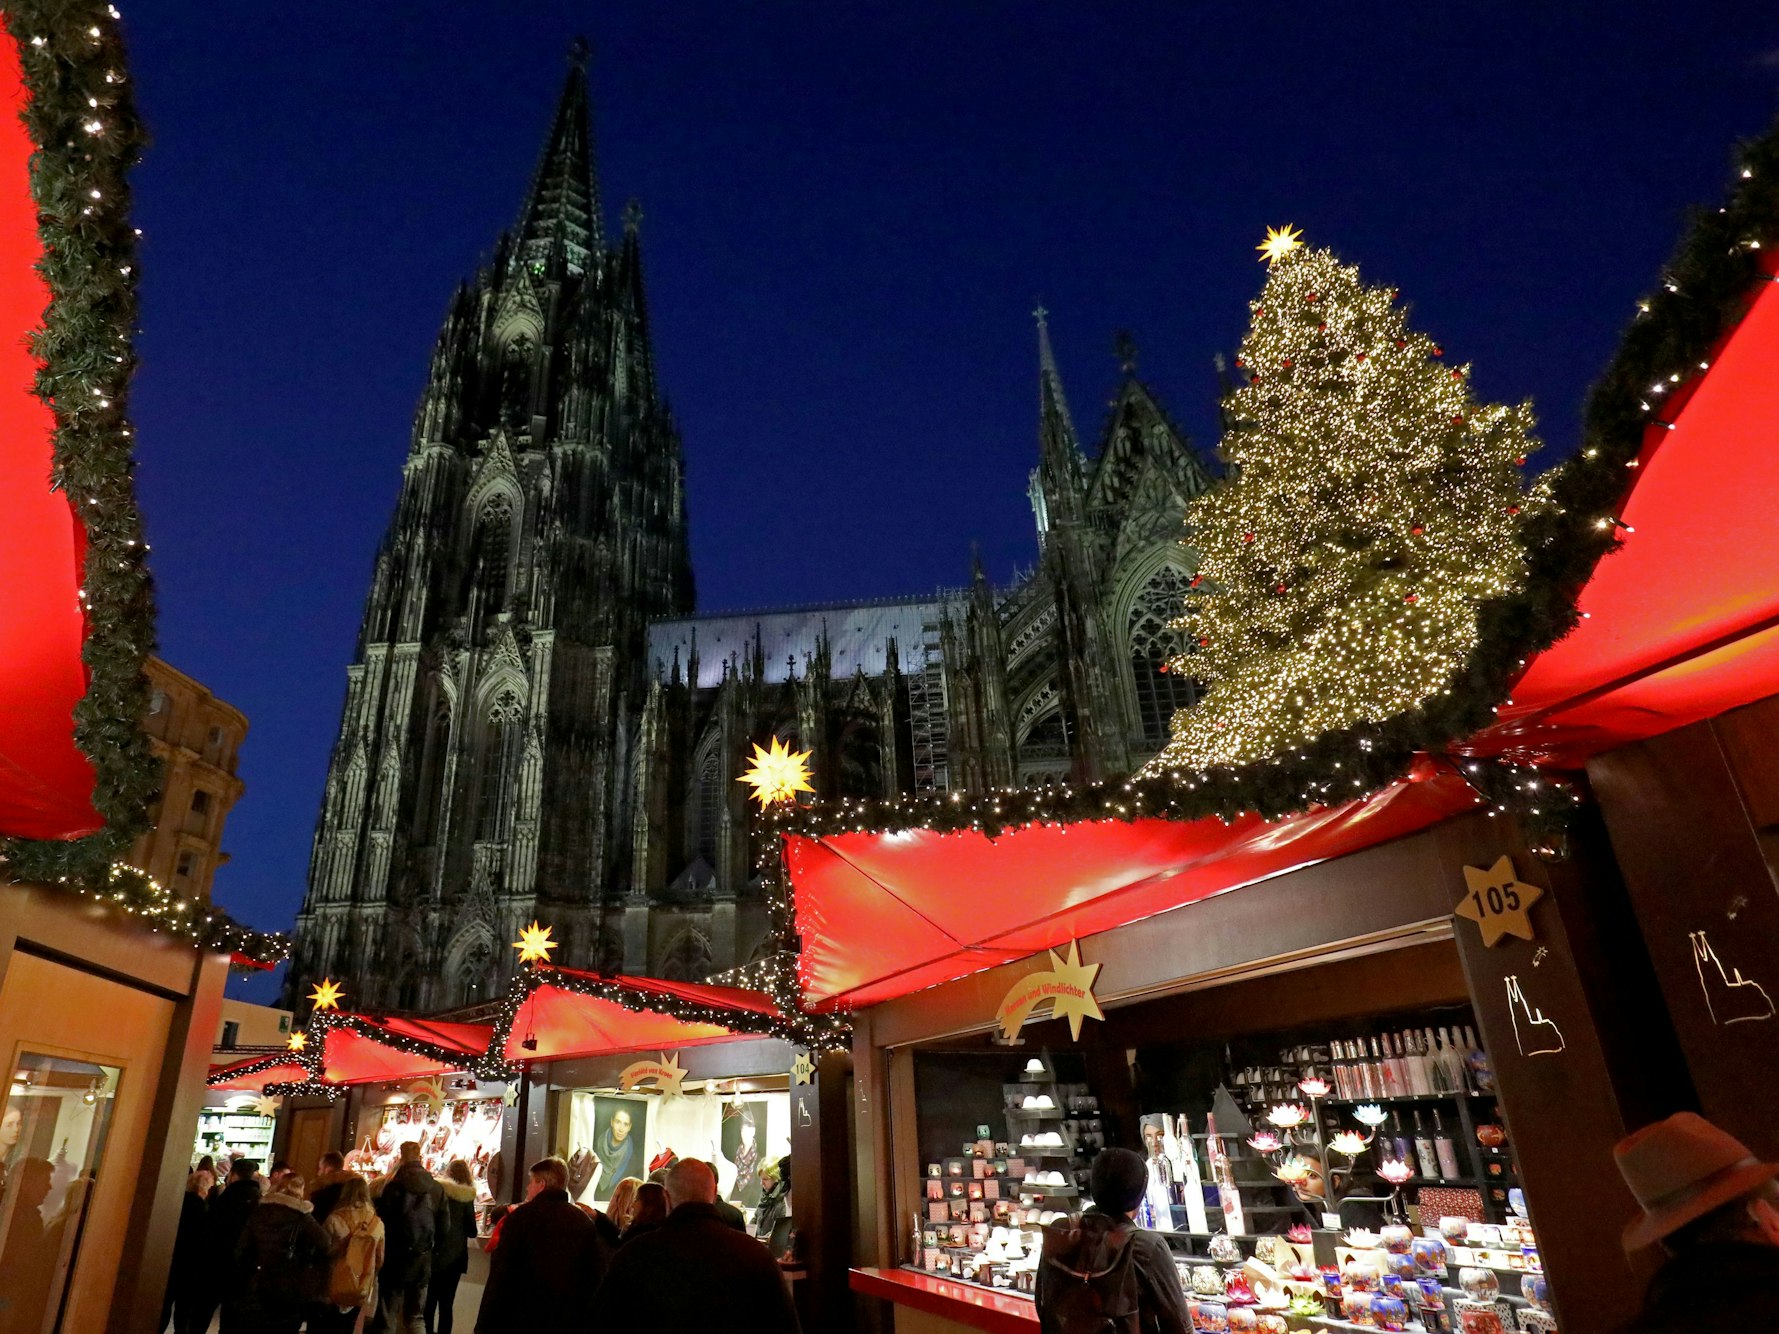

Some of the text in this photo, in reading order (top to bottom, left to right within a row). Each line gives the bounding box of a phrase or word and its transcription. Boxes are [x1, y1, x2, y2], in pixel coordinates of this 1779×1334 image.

[1472, 882, 1520, 918] 105
[1042, 982, 1085, 998] Windlichter
[796, 1063, 809, 1075] 104
